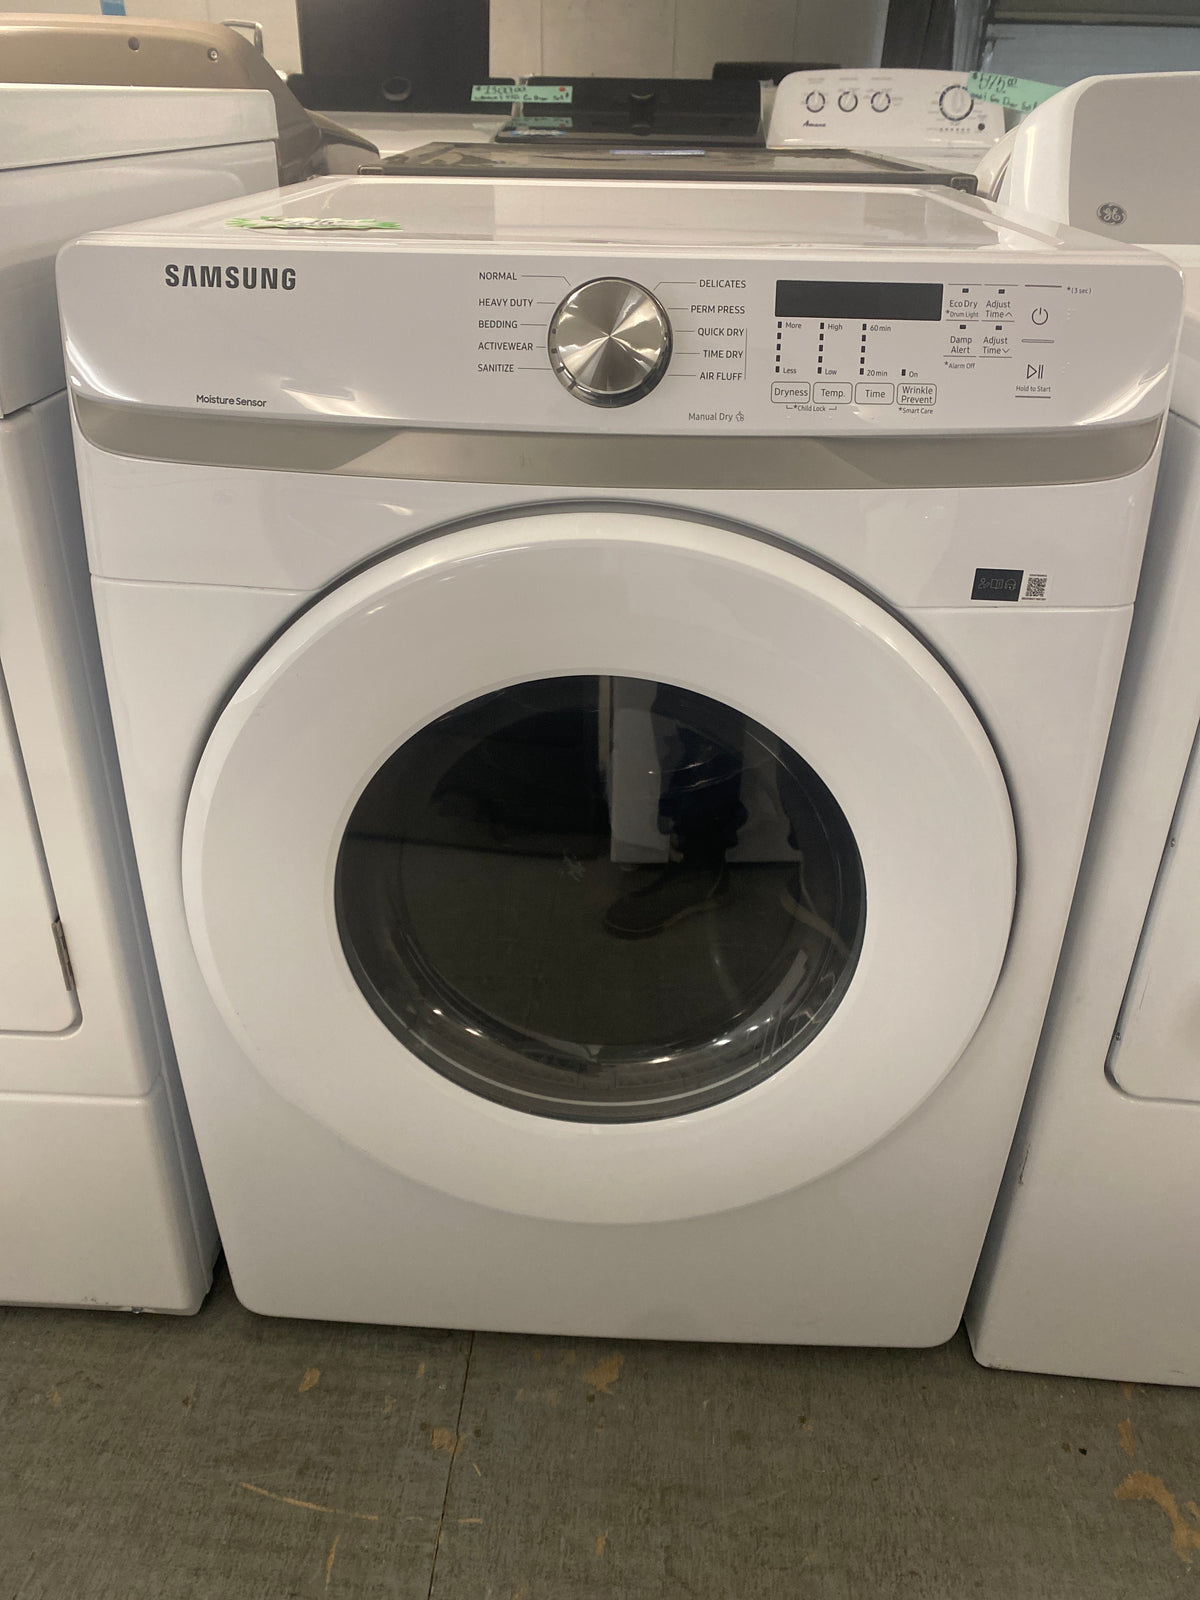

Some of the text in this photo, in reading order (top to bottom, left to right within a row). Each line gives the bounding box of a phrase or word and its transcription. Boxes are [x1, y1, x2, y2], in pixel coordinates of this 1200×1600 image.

[165, 264, 296, 290] SAMSUNG
[478, 271, 517, 281] NORMAL
[699, 279, 746, 289] DELICATES
[478, 298, 534, 307] HEAVY DUTY
[949, 300, 978, 309] Eco Dry
[985, 300, 1011, 309] Adjust
[690, 304, 746, 315] PERM PRESS
[985, 310, 1004, 318] Time
[965, 311, 979, 319] Light
[478, 319, 518, 329] BEDDING
[785, 321, 802, 329] More
[827, 323, 843, 332] High
[869, 324, 892, 332] 60 min
[697, 327, 745, 337] QUICK DRY
[950, 335, 973, 345] Damp
[983, 336, 1008, 345] Adjust
[477, 341, 534, 351] ACTIVEWEAR
[950, 345, 971, 354] Alert
[982, 346, 1002, 355] Time
[703, 349, 744, 359] TIME DRY
[477, 363, 515, 373] SANITIZE
[966, 362, 976, 370] Off
[783, 367, 797, 375] Less
[824, 368, 838, 376] Low
[866, 369, 888, 377] 20 min
[908, 370, 919, 378] On
[699, 371, 743, 381] AIR FLUFF
[774, 387, 808, 399] Dryness
[820, 388, 846, 399] Temp.
[902, 385, 934, 395] Wrinkle
[1015, 385, 1051, 393] Hold to Start
[865, 389, 886, 399] Time
[196, 394, 267, 408] Moisture Sensor
[901, 394, 933, 404] Prevent
[812, 404, 826, 412] Lock
[919, 407, 934, 415] Care
[688, 412, 734, 422] Manual Dry
